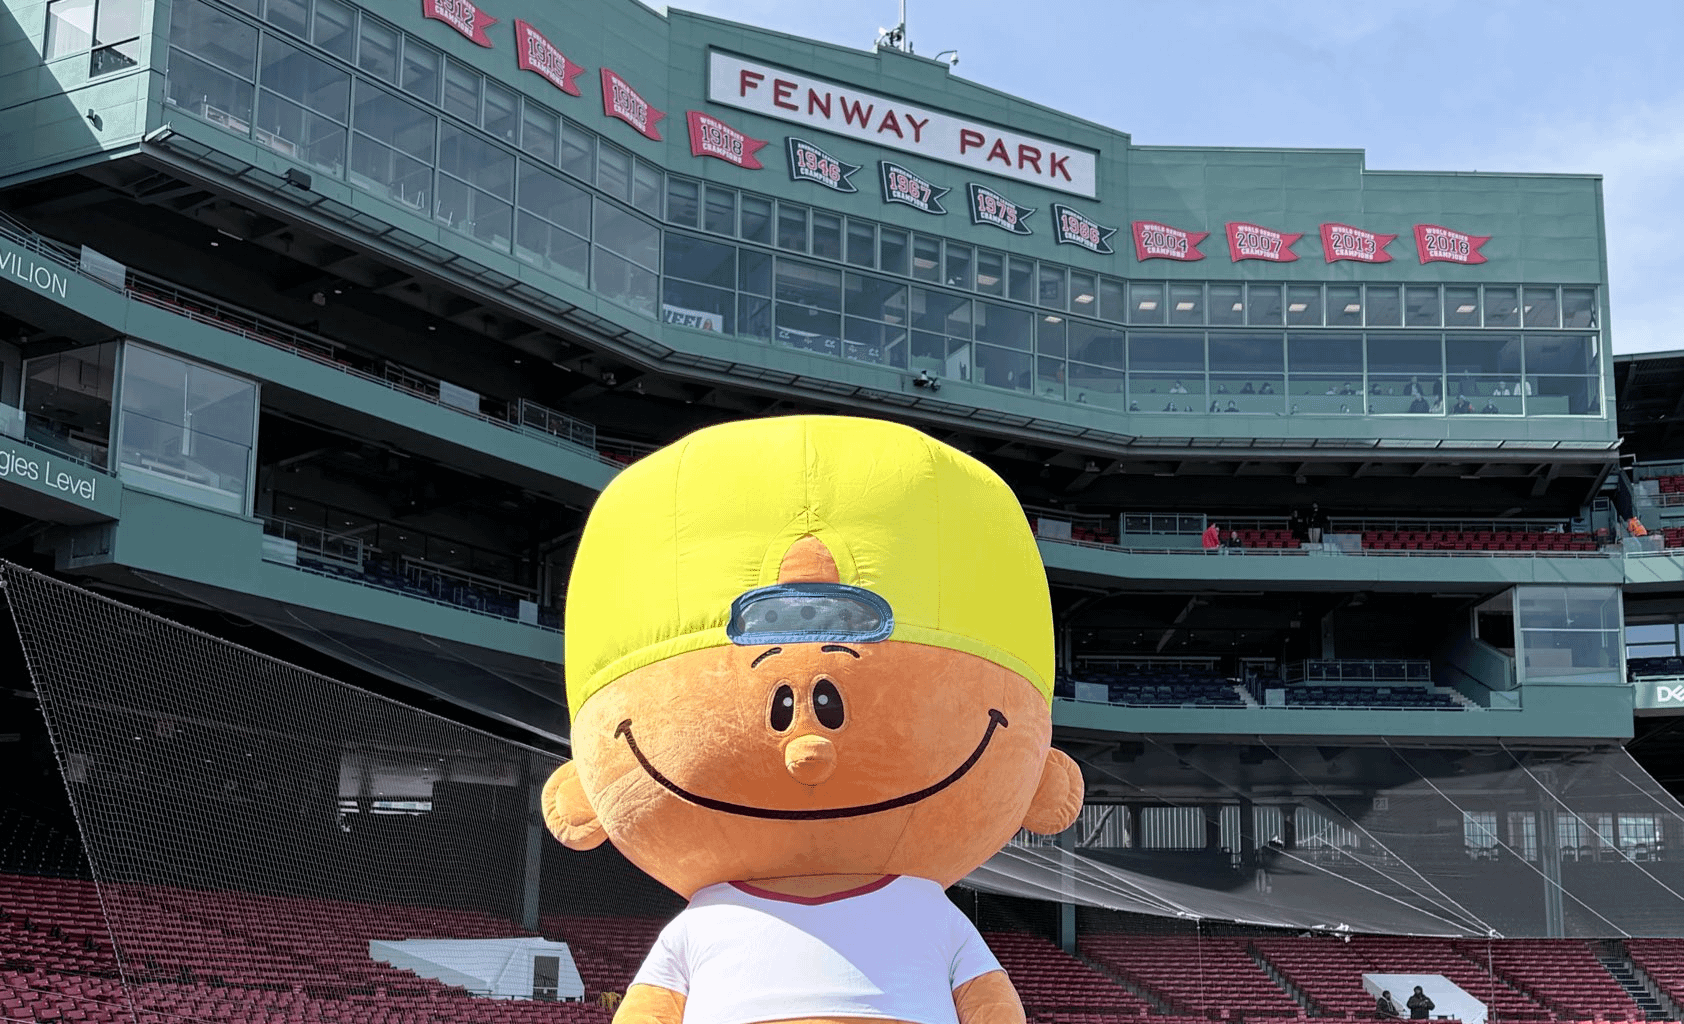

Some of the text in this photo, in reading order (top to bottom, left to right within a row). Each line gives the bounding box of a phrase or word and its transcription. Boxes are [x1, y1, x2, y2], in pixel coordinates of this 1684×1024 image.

[434, 0, 475, 30] 912
[528, 36, 565, 80] 1915
[612, 85, 648, 125] 1916
[701, 125, 743, 157] 1918
[740, 69, 1072, 182] FENWAY PARK
[797, 149, 841, 182] 1946
[889, 172, 931, 203] 1967
[977, 193, 1017, 224] 1975
[1141, 231, 1188, 253] 2004
[1236, 231, 1283, 253] 2007
[1331, 233, 1376, 254] 2013
[1425, 234, 1470, 256] 2018
[45, 461, 96, 500] Level
